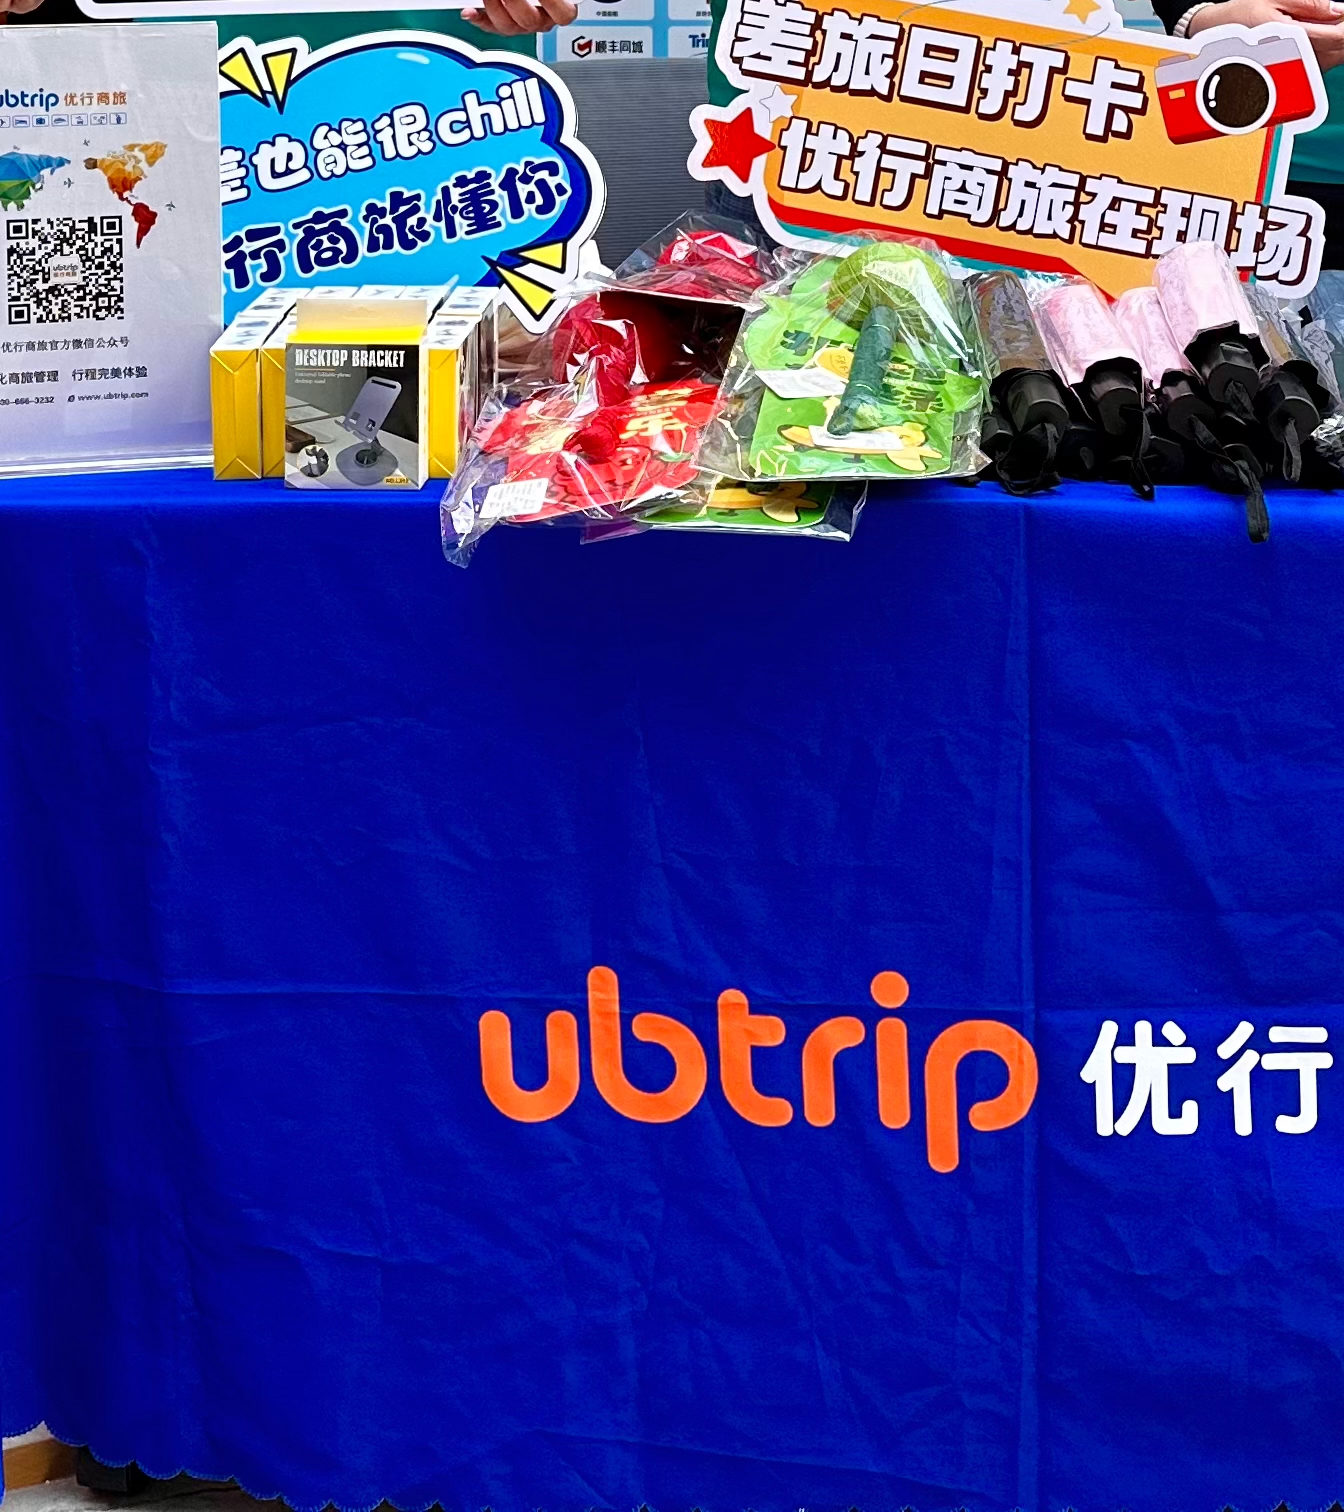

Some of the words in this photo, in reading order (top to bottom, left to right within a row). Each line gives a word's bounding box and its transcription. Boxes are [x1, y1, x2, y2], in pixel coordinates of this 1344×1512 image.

[595, 41, 644, 54] 顺丰同城
[689, 33, 709, 48] Tri
[64, 90, 127, 107] 优行商旅
[777, 116, 1313, 282] 优行商旅在现场
[224, 161, 570, 288] 行商旅懂你
[1, 336, 130, 353] 优行商旅官方微信公众号
[294, 348, 348, 367] DESKTOP
[351, 349, 406, 368] BRACKET
[72, 366, 148, 381] 行程完美体验
[479, 966, 1039, 1173] ubtrip
